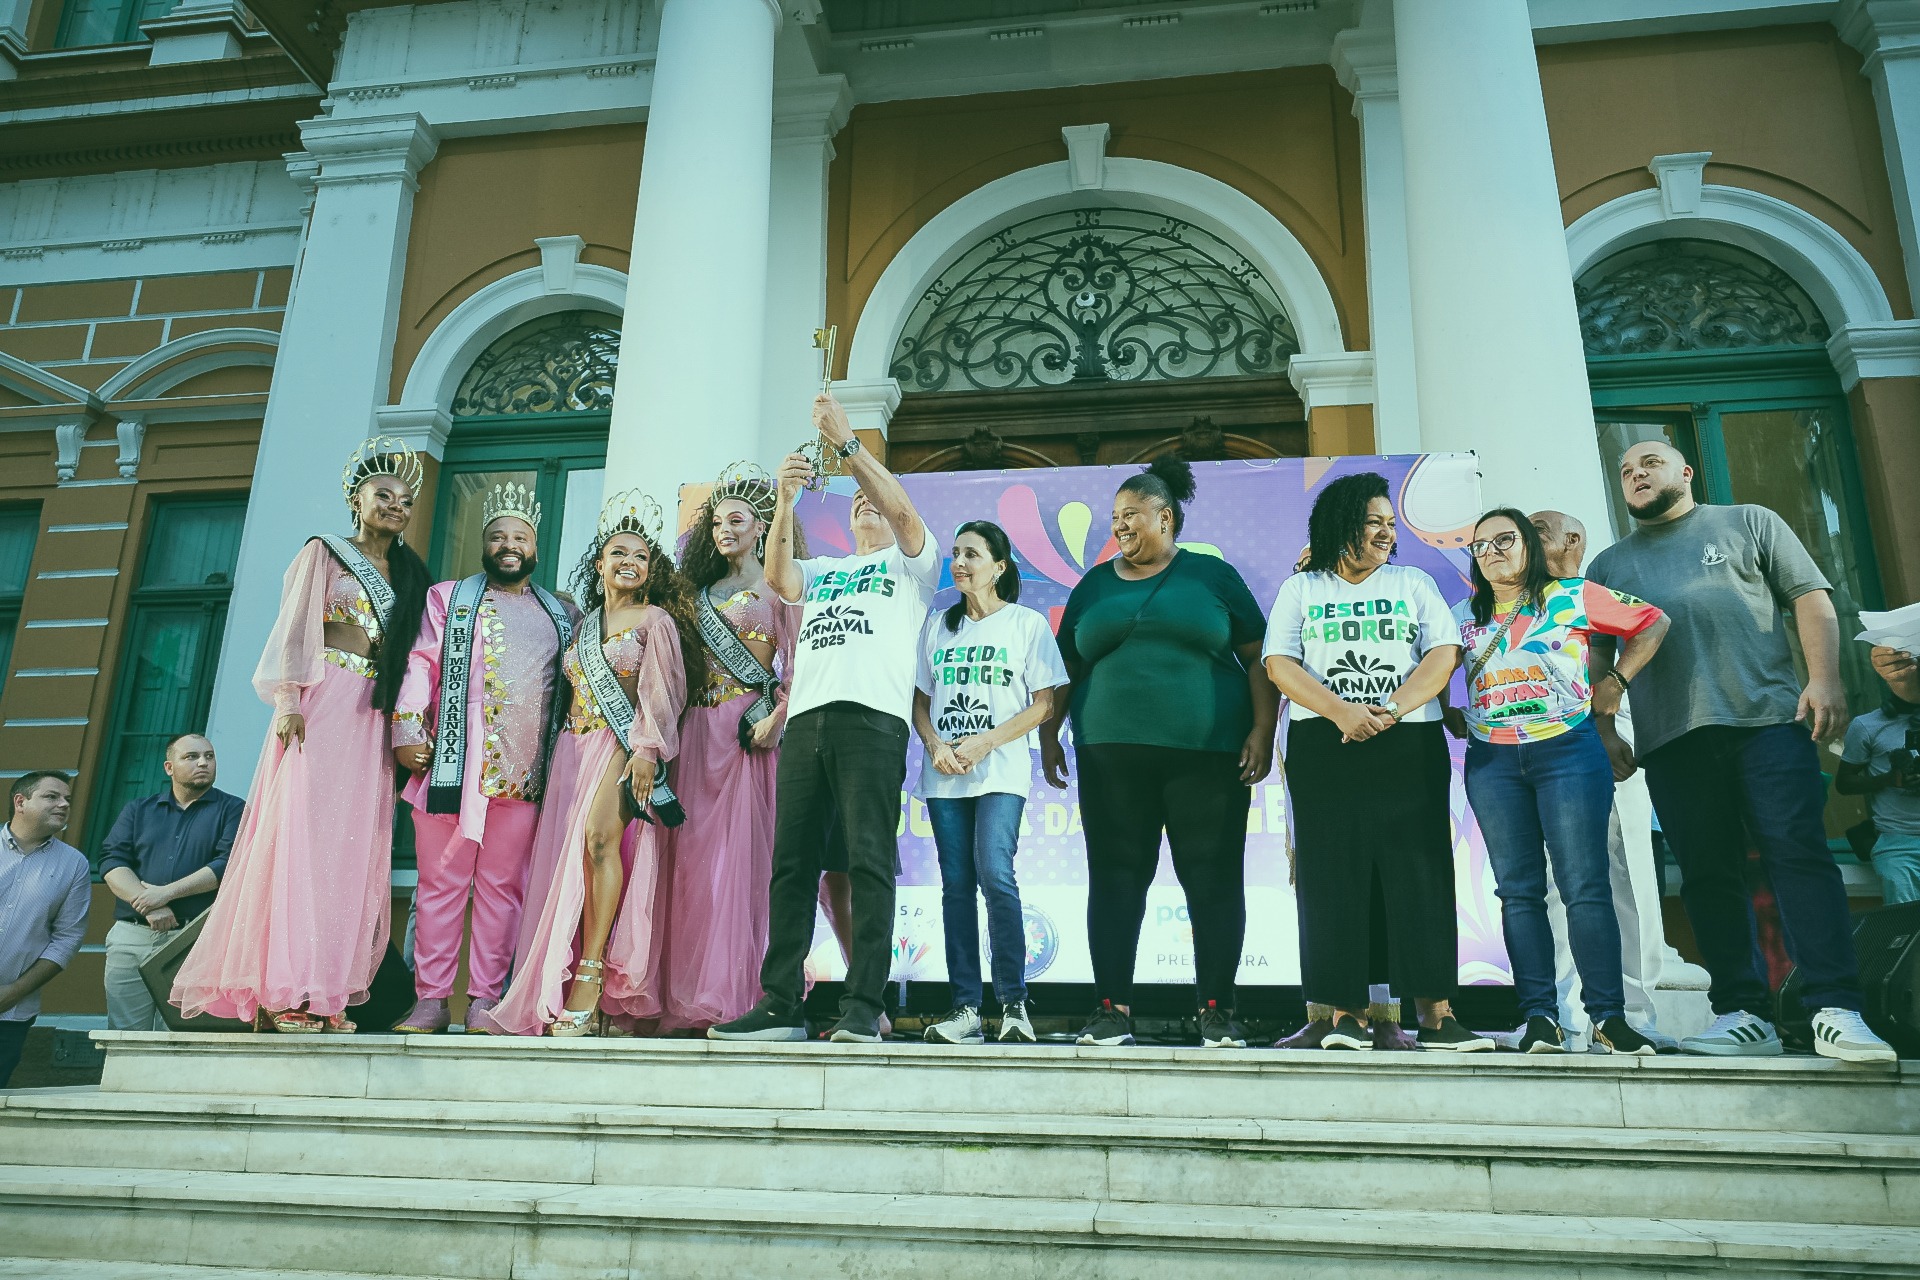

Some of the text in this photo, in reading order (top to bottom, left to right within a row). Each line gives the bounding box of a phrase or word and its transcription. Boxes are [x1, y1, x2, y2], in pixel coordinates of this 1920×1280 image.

[1308, 598, 1410, 622] DESCIDA
[799, 618, 874, 643] CARNAVAL
[811, 634, 846, 650] 2025
[1302, 619, 1419, 644] DA BORGES
[721, 648, 747, 674] ALEGRE
[730, 642, 752, 667] PORTO
[933, 645, 1008, 667] DESCIDA
[943, 665, 1014, 687] BORGES
[1475, 664, 1548, 692] SAMBA
[441, 627, 466, 764] REI MOMO CARNAVAL
[937, 714, 995, 732] CARNAVAL
